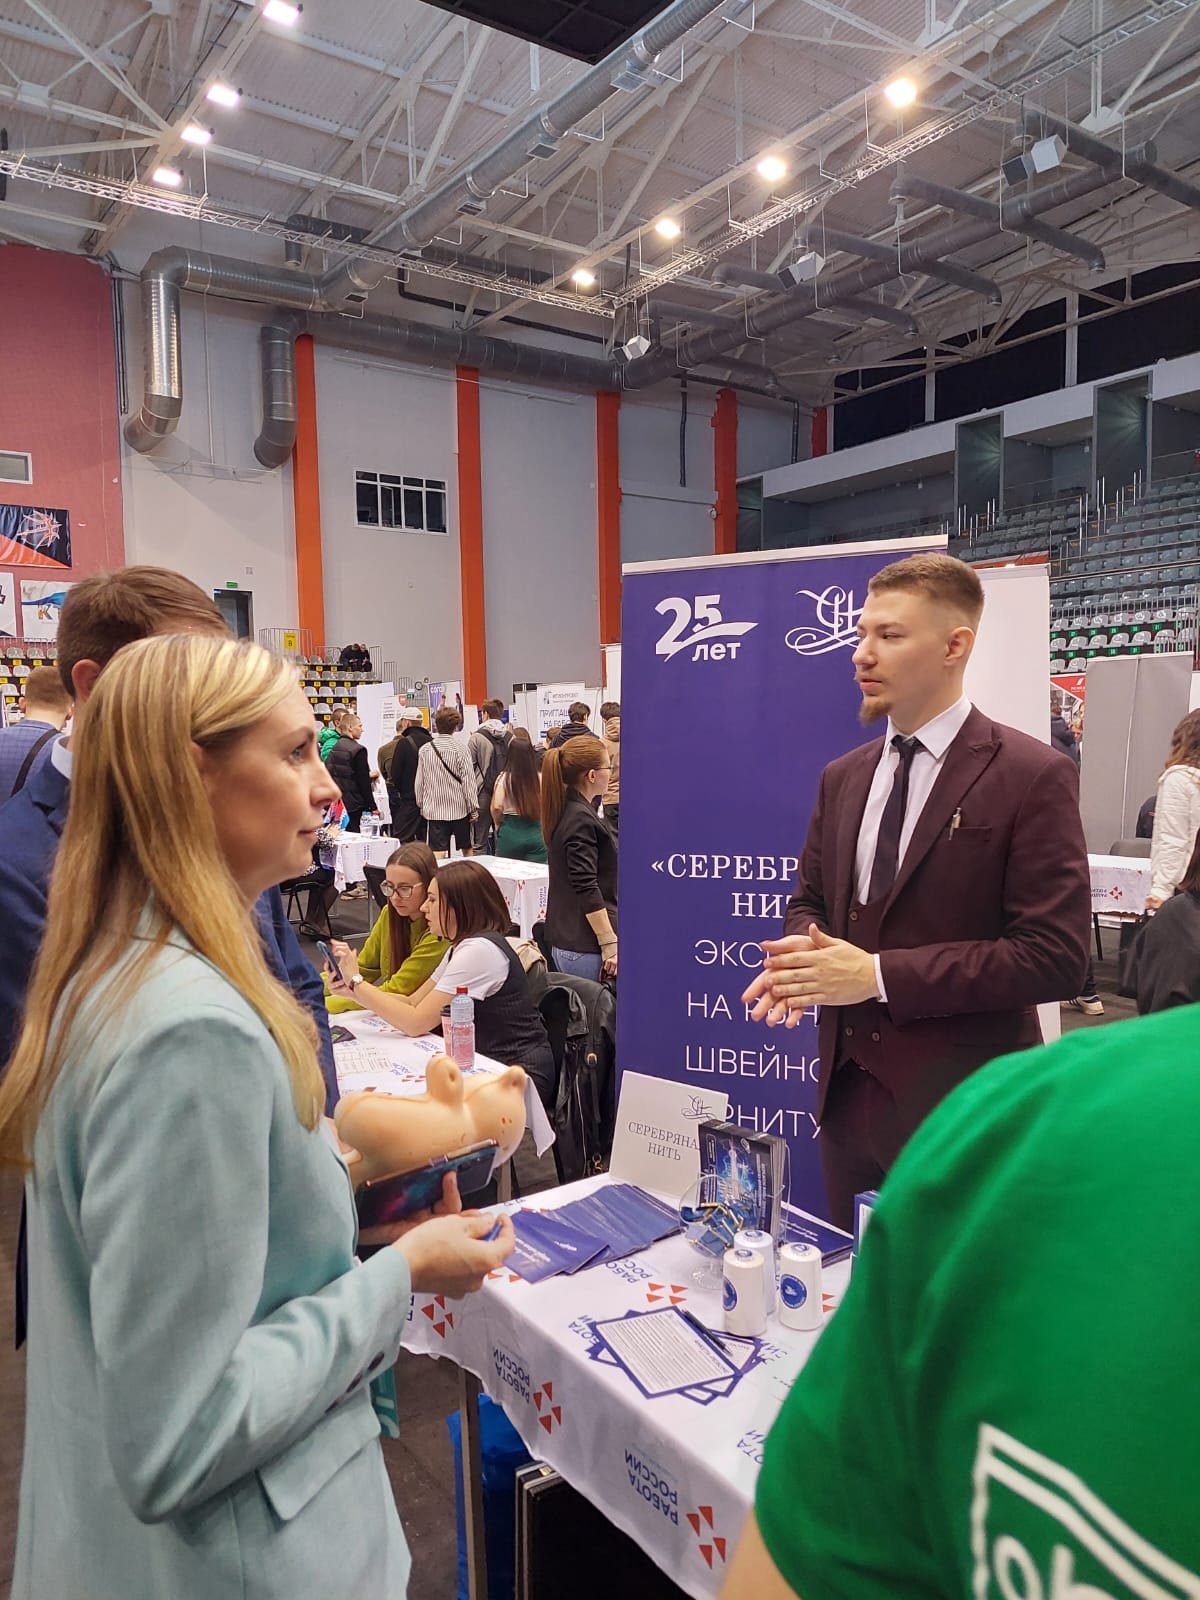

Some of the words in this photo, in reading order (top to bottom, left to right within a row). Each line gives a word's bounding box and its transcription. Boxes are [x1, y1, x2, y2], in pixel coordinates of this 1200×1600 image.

[655, 594, 723, 655] 25
[692, 642, 741, 661] лет
[694, 939, 770, 968] ЭКС
[687, 992, 732, 1020] НА
[628, 1121, 698, 1150] СЕРЕБРЯНА
[647, 1142, 681, 1161] НИТЬ
[493, 1349, 530, 1387] РОССИИ
[496, 1362, 530, 1404] РАБОТА
[624, 1448, 678, 1506] РОССИИ
[628, 1469, 679, 1526] РАБОТА
